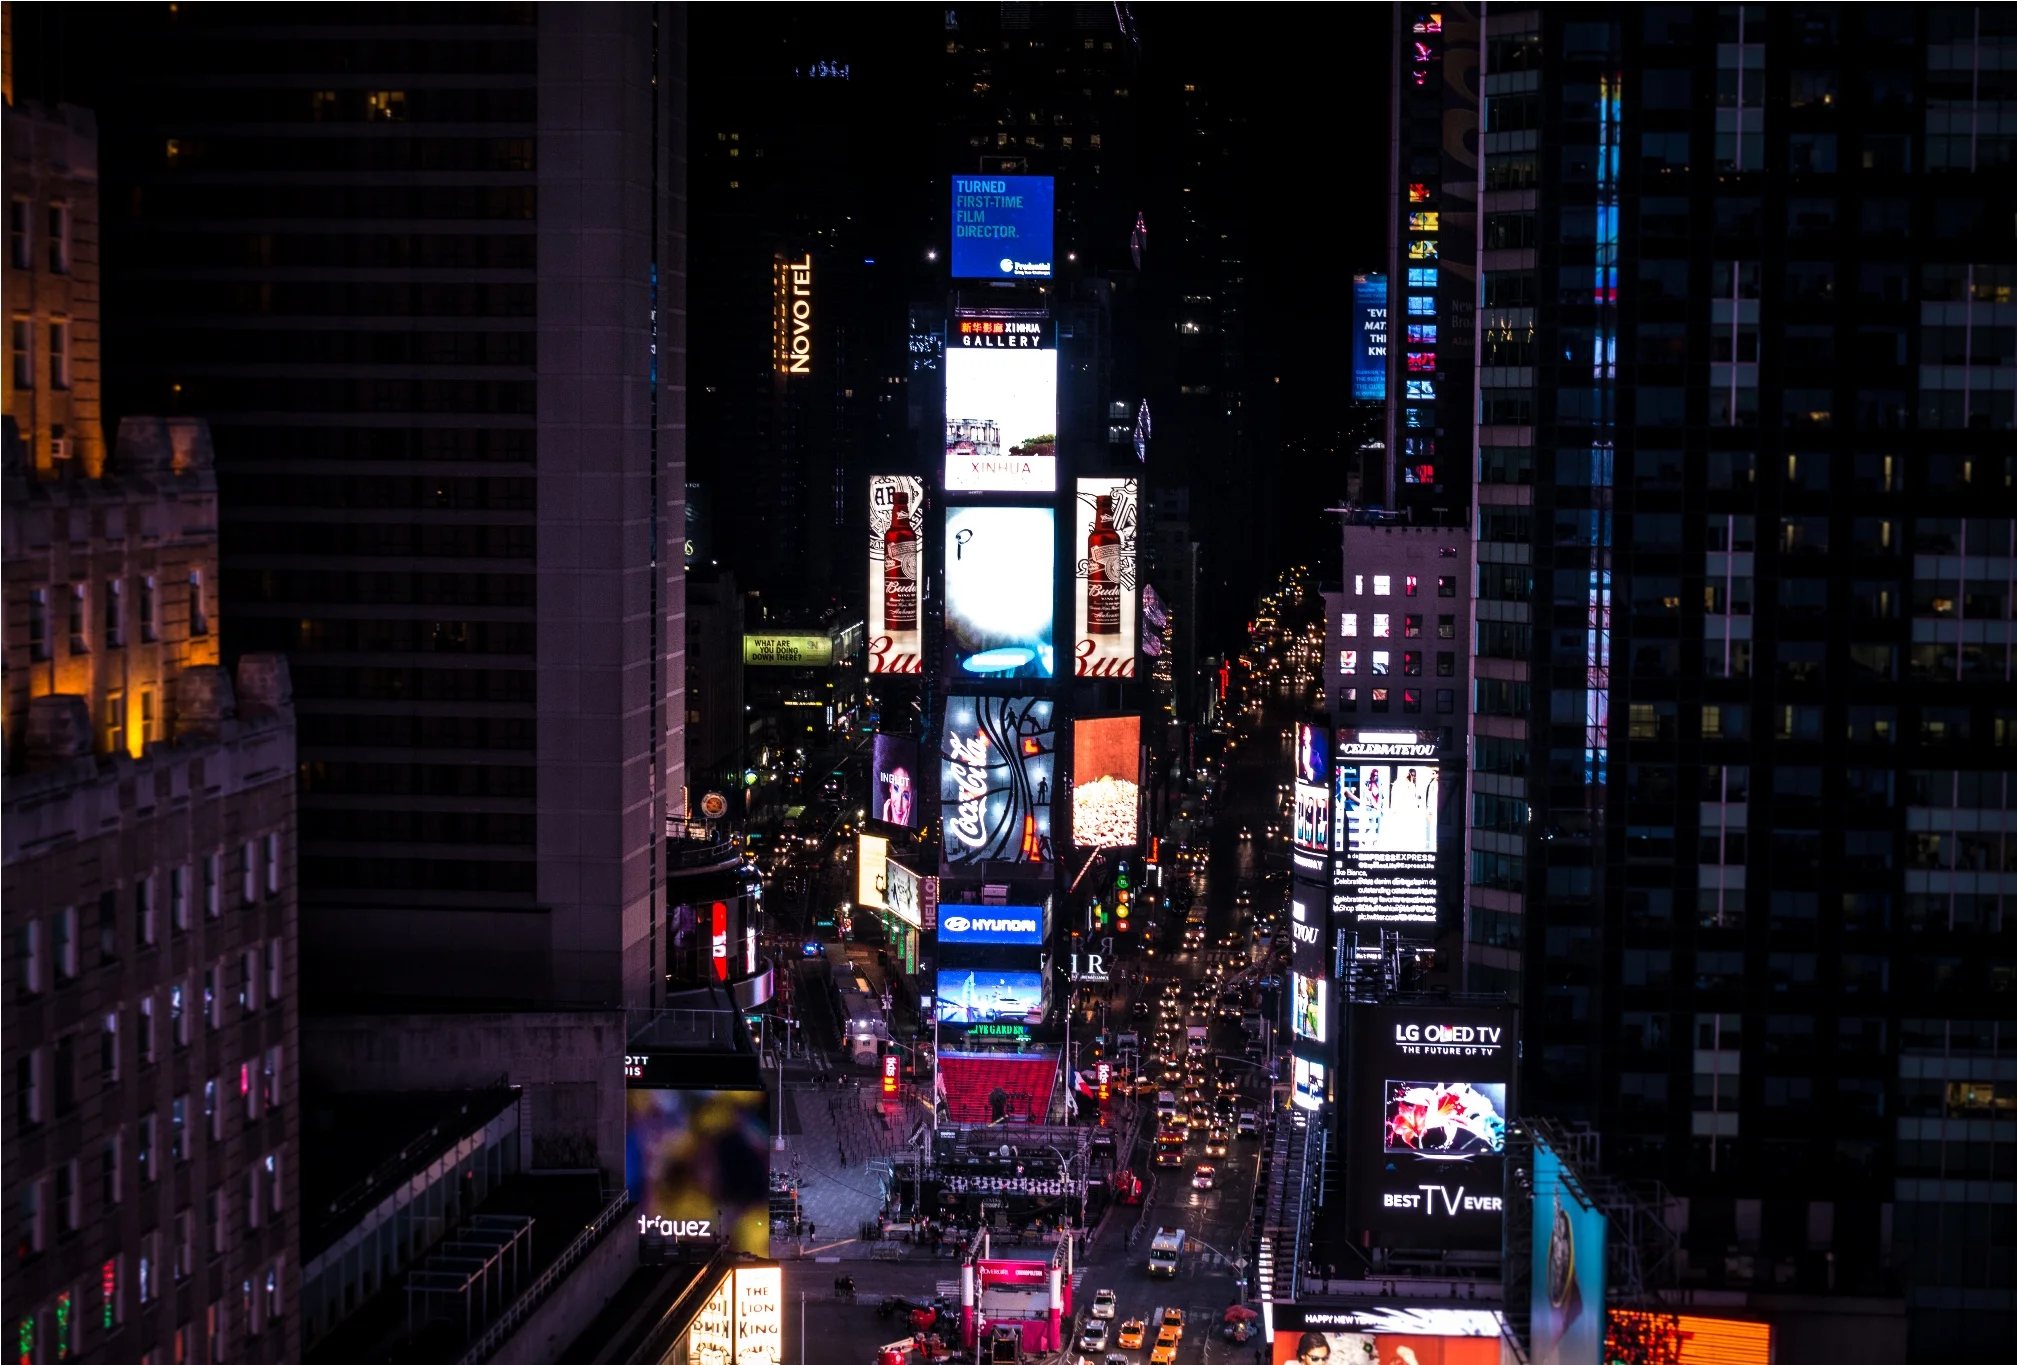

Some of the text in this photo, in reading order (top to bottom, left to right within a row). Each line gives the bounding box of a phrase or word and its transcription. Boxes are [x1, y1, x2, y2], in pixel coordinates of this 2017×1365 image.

[957, 180, 1006, 193] TURNED
[957, 196, 1024, 208] FIRST-TIME
[957, 210, 985, 222] FILM
[957, 225, 1019, 238] DIRECTOR.
[789, 254, 811, 374] NOVOTEL
[1005, 323, 1040, 333] XINHUA
[1364, 321, 1387, 330] MAT
[963, 335, 1040, 347] GALLERY
[971, 462, 1031, 474] XINHUA
[754, 639, 775, 647] WHAT
[759, 646, 798, 654] YOU DOING
[752, 653, 774, 661] DOWN
[880, 771, 910, 787] INGLOT
[972, 918, 1036, 932] HYUNDAI
[989, 1024, 1024, 1035] GARDEN
[1396, 1024, 1501, 1043] LG OLED TV
[1402, 1046, 1493, 1055] THE FUTURE OF TV
[1383, 1184, 1502, 1216] BEST TV EVER
[745, 1286, 769, 1296] THE
[741, 1301, 775, 1317] LION
[1305, 1314, 1333, 1324] HAPPY
[1334, 1315, 1354, 1325] NEW
[739, 1320, 778, 1339] KING
